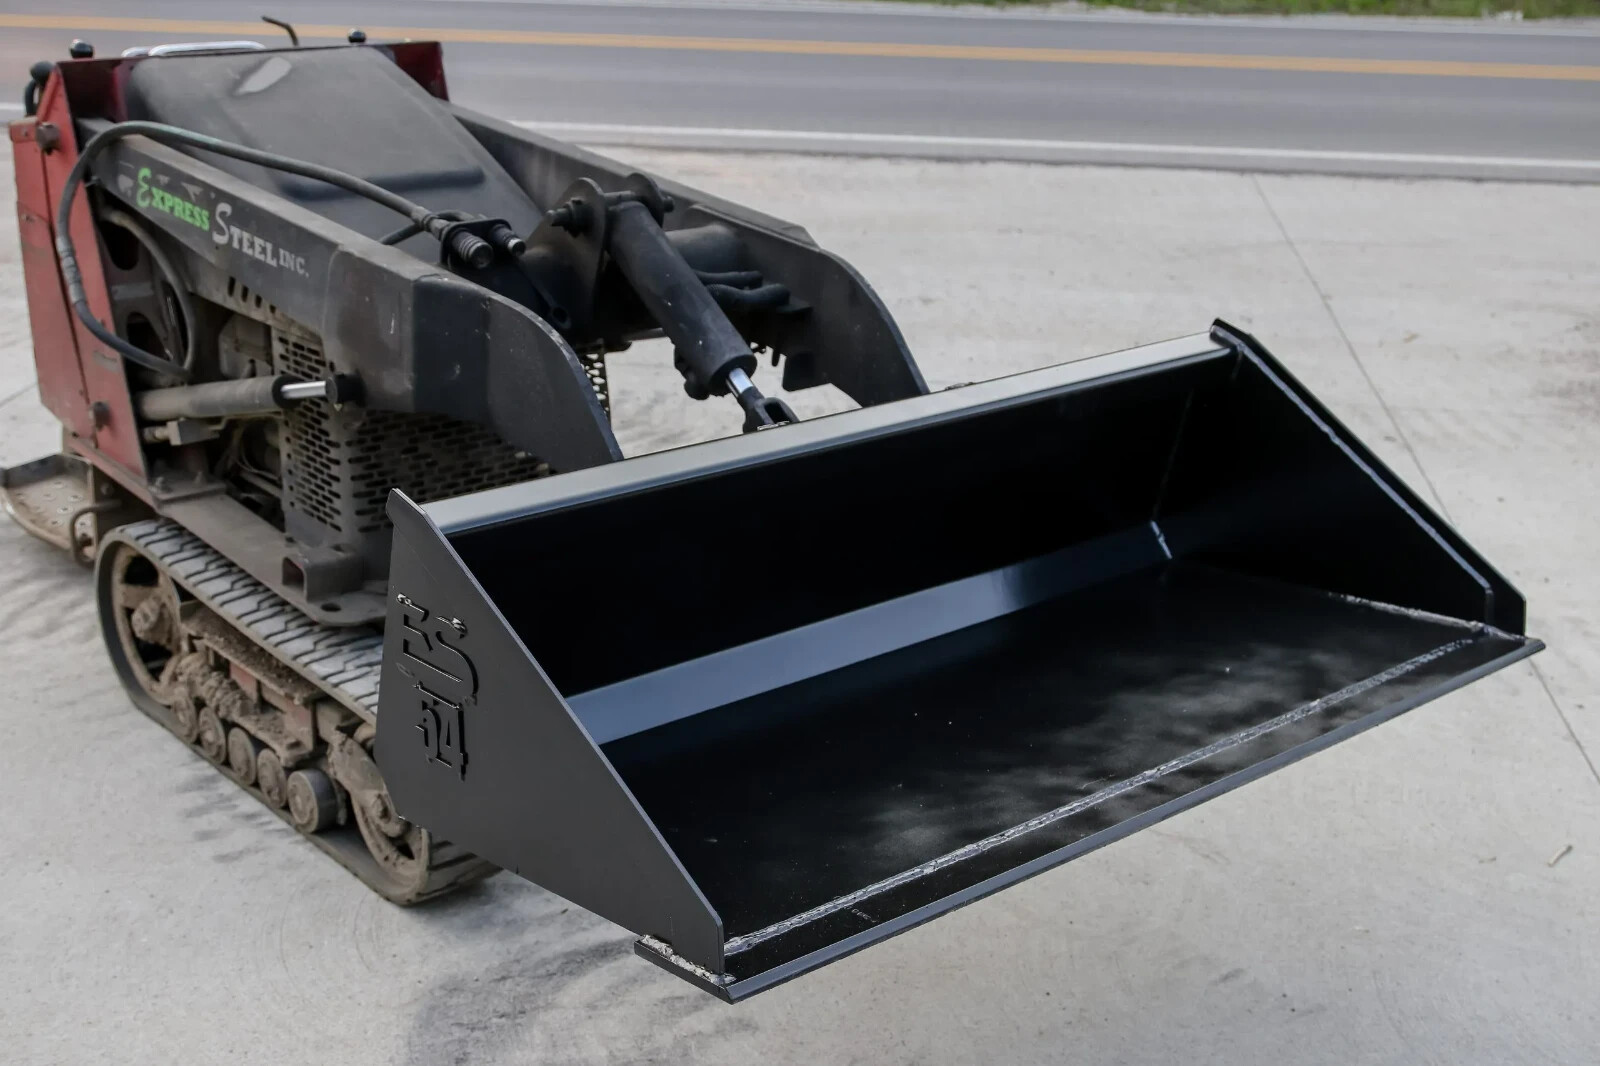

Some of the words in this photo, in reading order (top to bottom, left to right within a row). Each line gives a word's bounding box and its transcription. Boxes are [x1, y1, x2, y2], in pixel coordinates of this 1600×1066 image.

[136, 167, 210, 231] EXPRESS
[212, 202, 277, 268] STEEL
[278, 247, 310, 279] INC.
